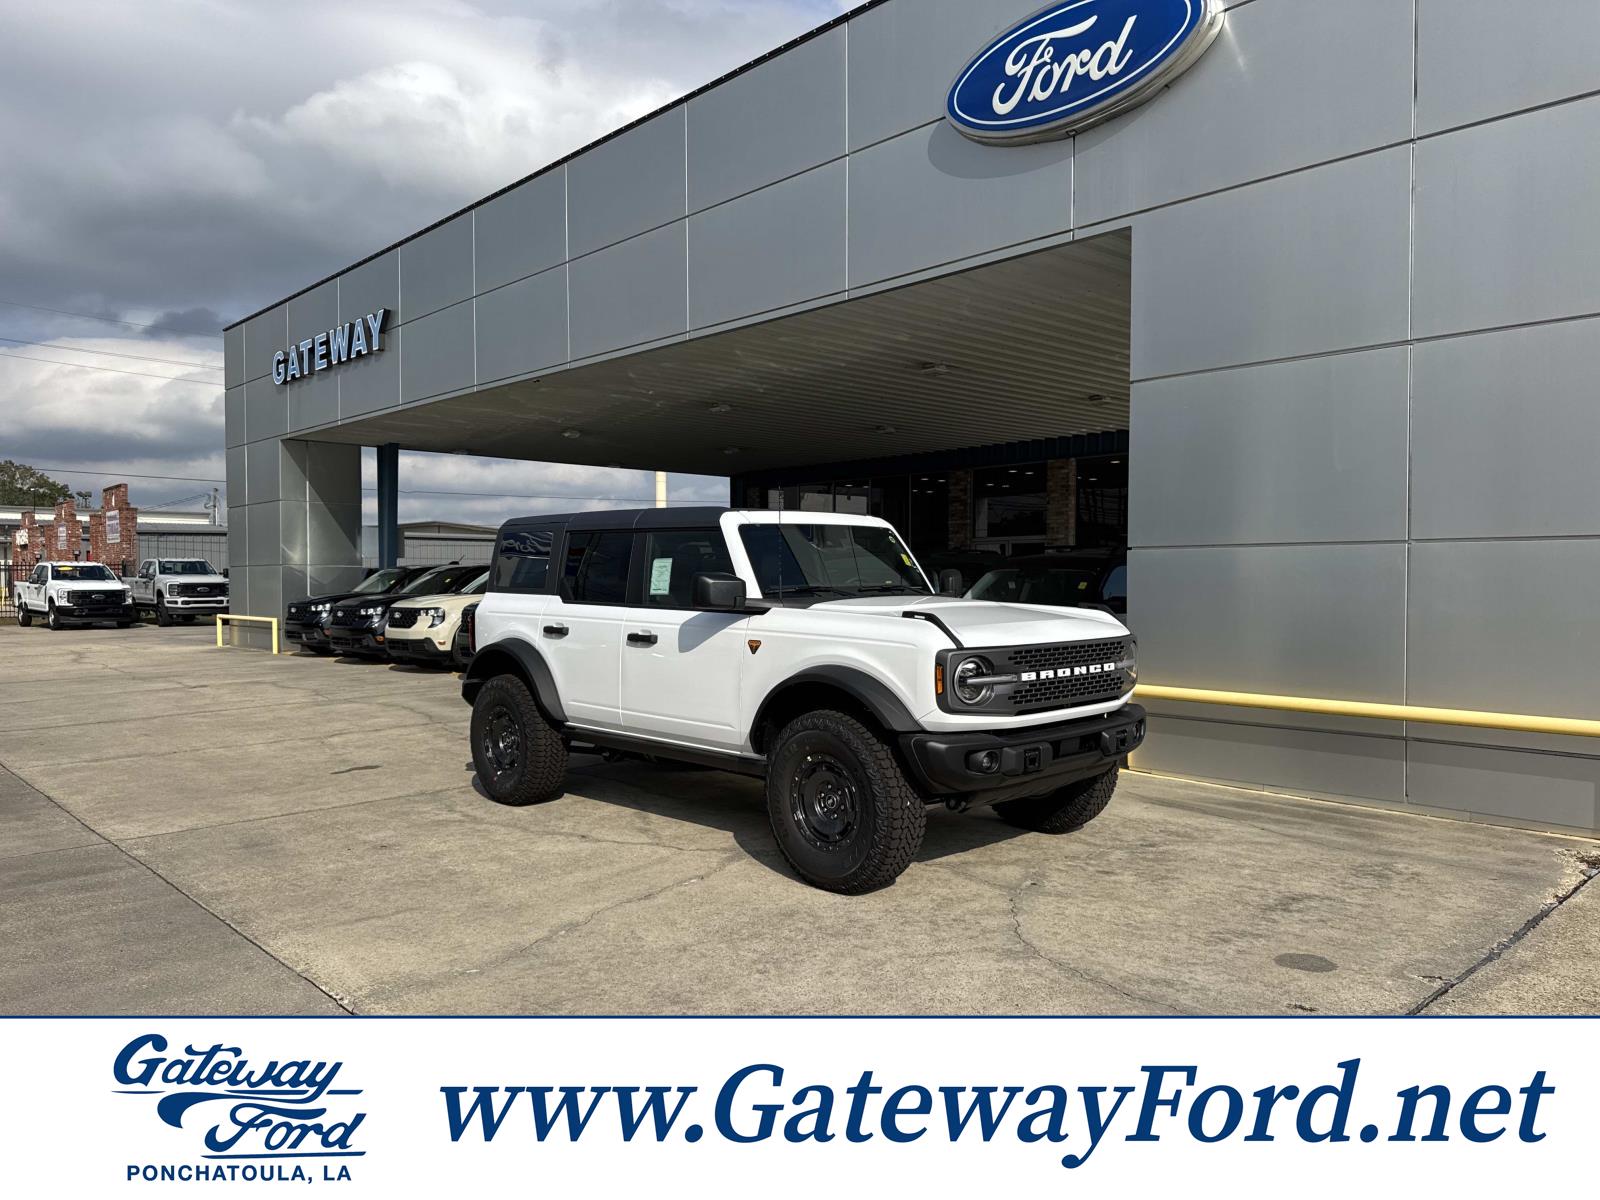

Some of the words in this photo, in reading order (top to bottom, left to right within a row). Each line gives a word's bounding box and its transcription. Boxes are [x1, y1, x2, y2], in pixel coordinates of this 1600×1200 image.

[992, 14, 1138, 116] Ford
[272, 308, 386, 385] GATEWAY
[1021, 662, 1115, 682] BRONCO
